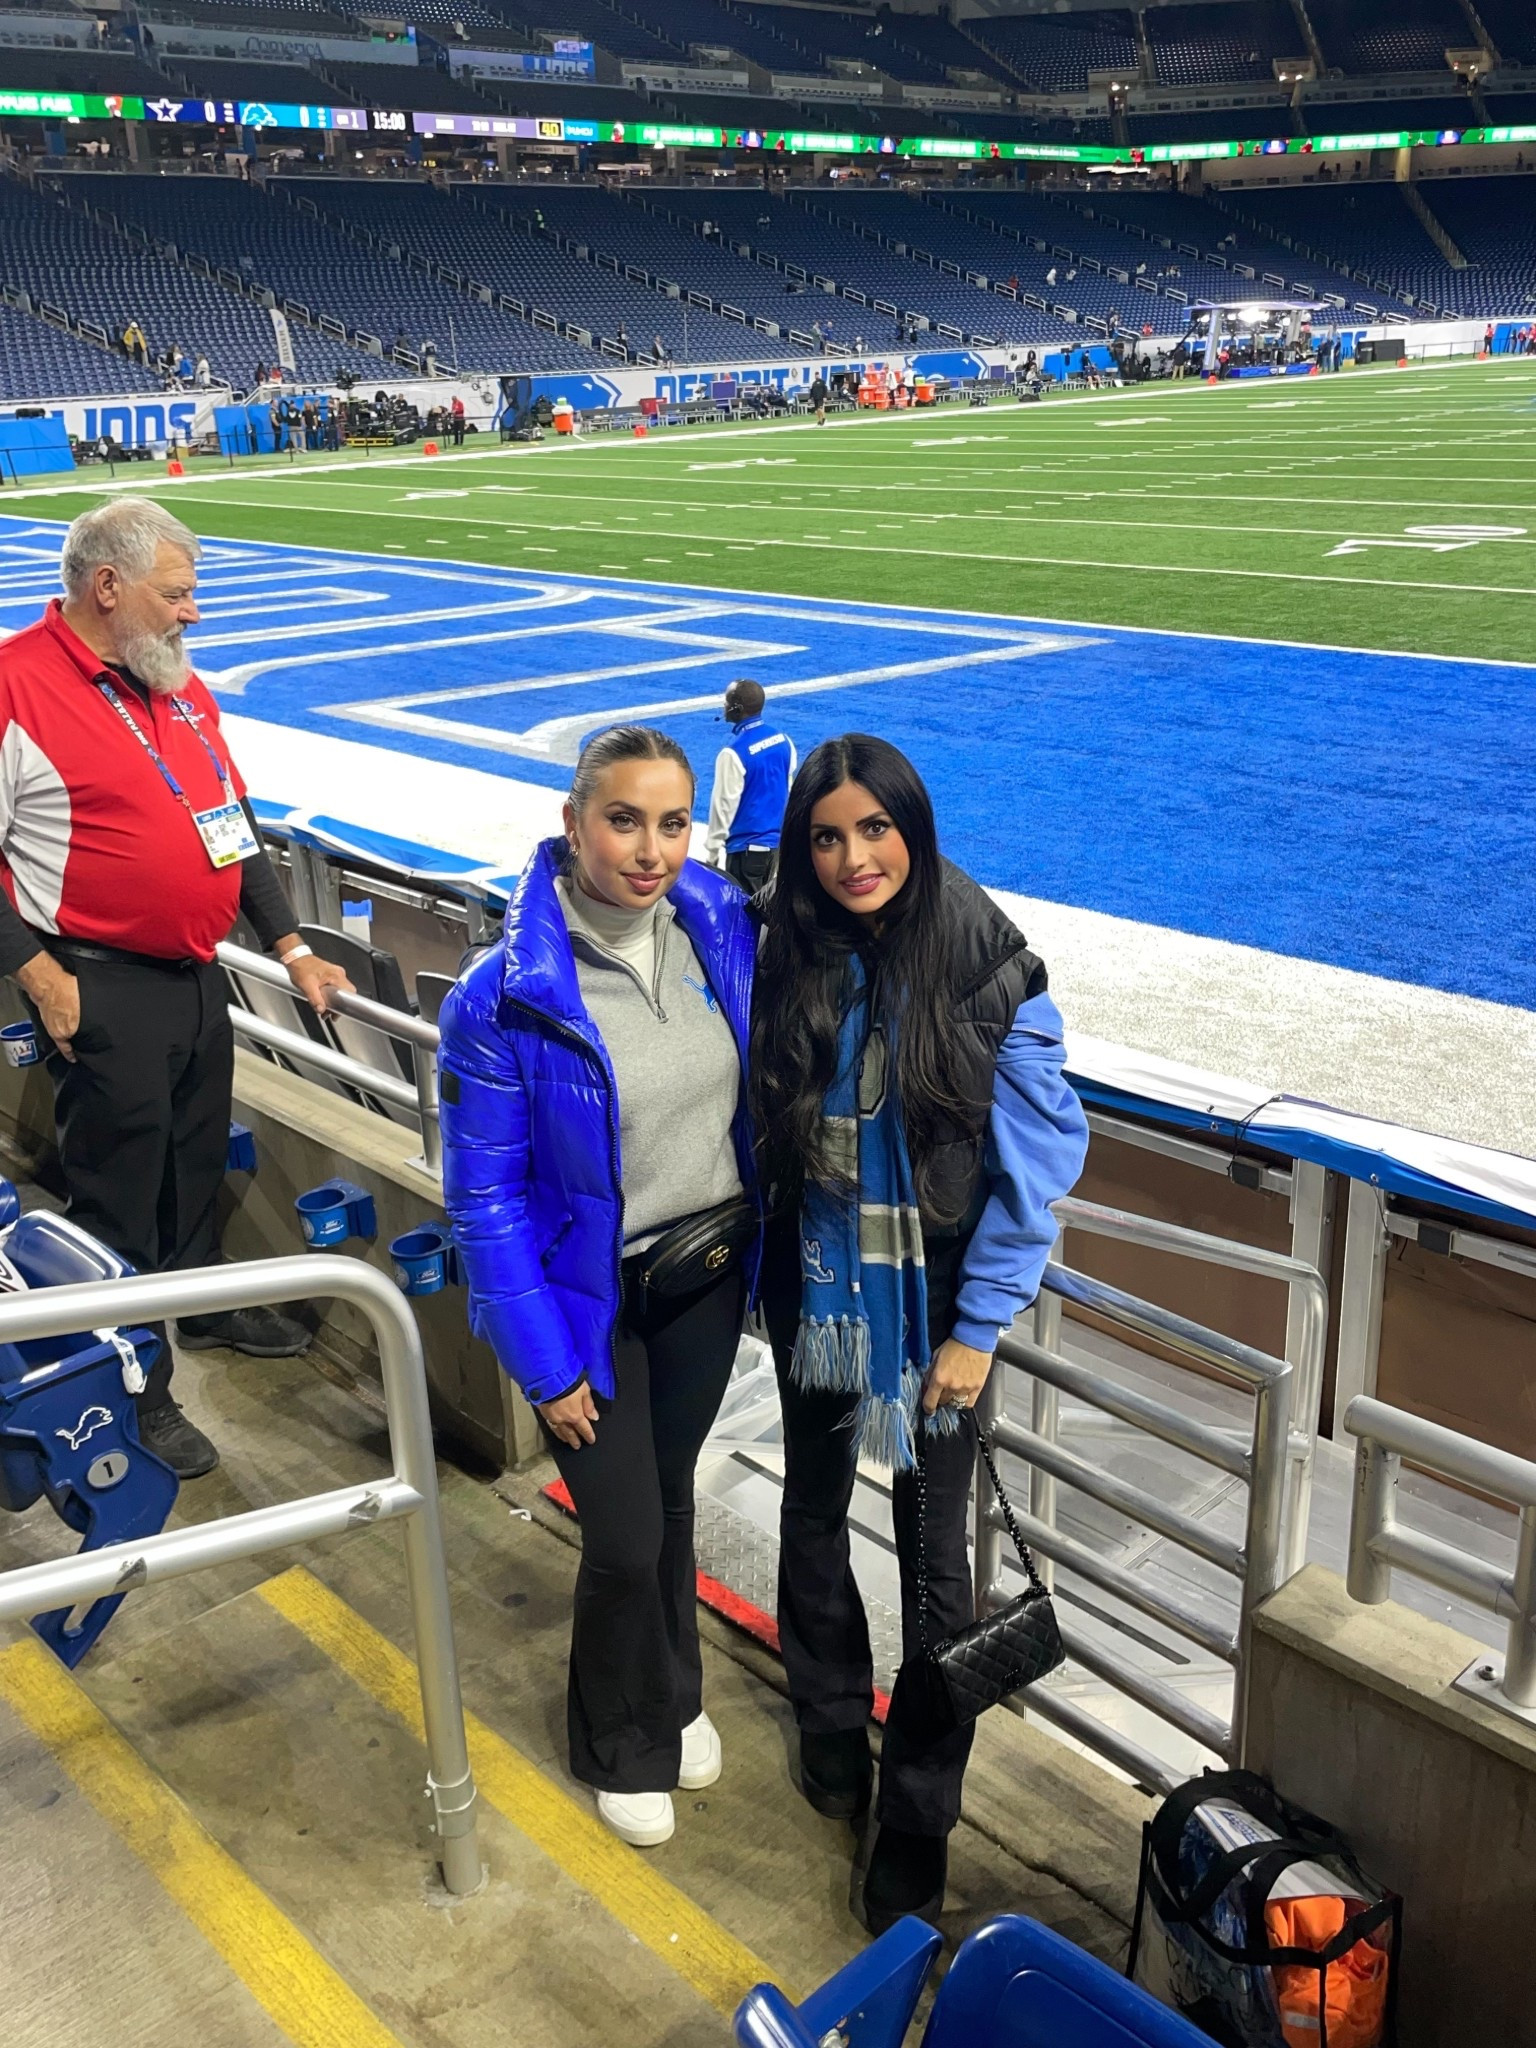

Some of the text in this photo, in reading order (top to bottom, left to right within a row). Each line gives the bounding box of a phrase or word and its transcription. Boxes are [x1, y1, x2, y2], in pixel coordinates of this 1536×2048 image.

[204, 101, 216, 123] 0
[299, 106, 310, 128] 0
[373, 111, 406, 131] 15:00
[541, 122, 559, 137] 40
[102, 1460, 115, 1479] 1
